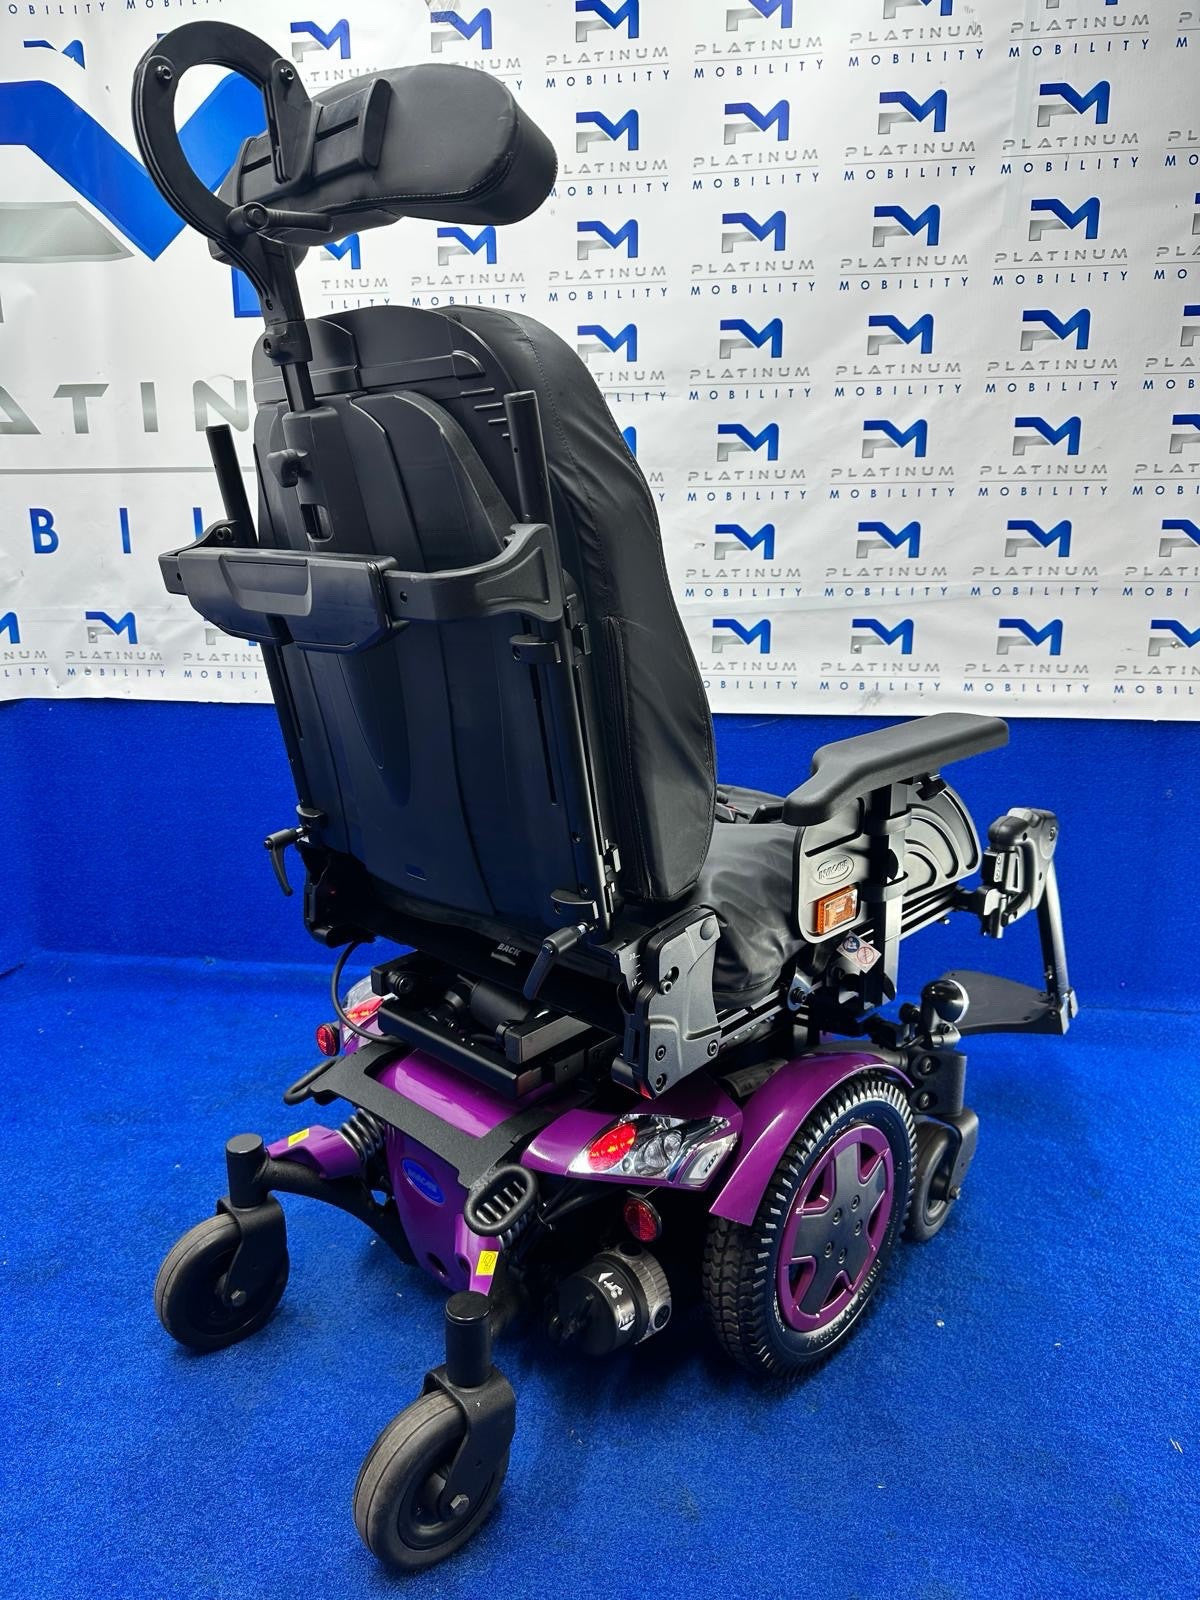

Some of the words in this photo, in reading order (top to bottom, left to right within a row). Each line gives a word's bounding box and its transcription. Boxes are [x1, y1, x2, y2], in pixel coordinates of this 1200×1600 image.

[8, 2, 105, 15] OBILITY
[1011, 14, 1149, 33] PLATINUM
[850, 23, 982, 44] PLATINUM
[695, 36, 822, 55] PLATINUM
[1009, 39, 1149, 57] MOBILITY
[546, 46, 668, 65] PLATINUM
[848, 48, 983, 67] MOBILITY
[694, 59, 823, 78] MOBILITY
[546, 70, 669, 88] MOBILITY
[1003, 133, 1138, 150] PLATINUM
[845, 141, 975, 157] PLATINUM
[693, 149, 818, 168] PLATINUM
[564, 160, 668, 174] LATINUM
[1001, 157, 1138, 174] MOBILITY
[844, 165, 976, 181] MOBILITY
[692, 172, 819, 190] MOBILITY
[840, 255, 967, 268] PLATINUM
[995, 248, 1127, 263] PLATINUM
[549, 266, 666, 280] PLATINUM
[691, 260, 814, 274] PLATINUM
[321, 278, 388, 289] TINUM
[411, 272, 525, 286] PLATINUM
[839, 277, 968, 291] MOBILITY
[993, 271, 1128, 285] MOBILITY
[691, 281, 815, 296] MOBILITY
[412, 294, 526, 306] MOBILITY
[549, 288, 667, 302] MOBILITY
[331, 298, 390, 309] ILITY
[836, 363, 960, 375] PLATINUM
[987, 359, 1117, 371] PLATINUM
[594, 370, 664, 382] TINUM
[690, 367, 810, 379] PLATINUM
[835, 384, 961, 397] MOBILITY
[985, 381, 1117, 393] MOBILITY
[616, 392, 666, 402] LITY
[689, 388, 811, 400] MOBILITY
[831, 466, 954, 478] PLATINUM
[980, 464, 1107, 475] PLATINUM
[1135, 463, 1200, 473] PLAT
[688, 469, 805, 481] PLATINUM
[687, 491, 806, 501] MOBILITY
[829, 488, 955, 499] MOBILITY
[978, 486, 1107, 496] MOBILITY
[1132, 485, 1200, 495] MOBI
[686, 568, 800, 578] PLATINUM
[826, 567, 947, 577] PLATINUM
[972, 567, 1098, 576] PLATINUM
[1125, 567, 1199, 576] PLATI
[685, 588, 802, 598] MOBILITY
[824, 587, 948, 596] MOBILITY
[970, 587, 1098, 596] MOBILITY
[1122, 587, 1188, 596] MOBI
[66, 651, 162, 660] PLATINUM
[700, 662, 796, 671] LATINUM
[821, 663, 939, 672] PLATINUM
[965, 664, 1088, 673] PLATINUM
[1115, 665, 1200, 675] PLATIN
[4, 668, 49, 678] LITY
[184, 670, 257, 680] MOBILI
[704, 680, 797, 690] OBILITY
[819, 681, 940, 691] MOBILITY
[964, 683, 1089, 693] MOBILITY
[1114, 685, 1194, 695] MOBIL
[497, 943, 520, 956] BACK
